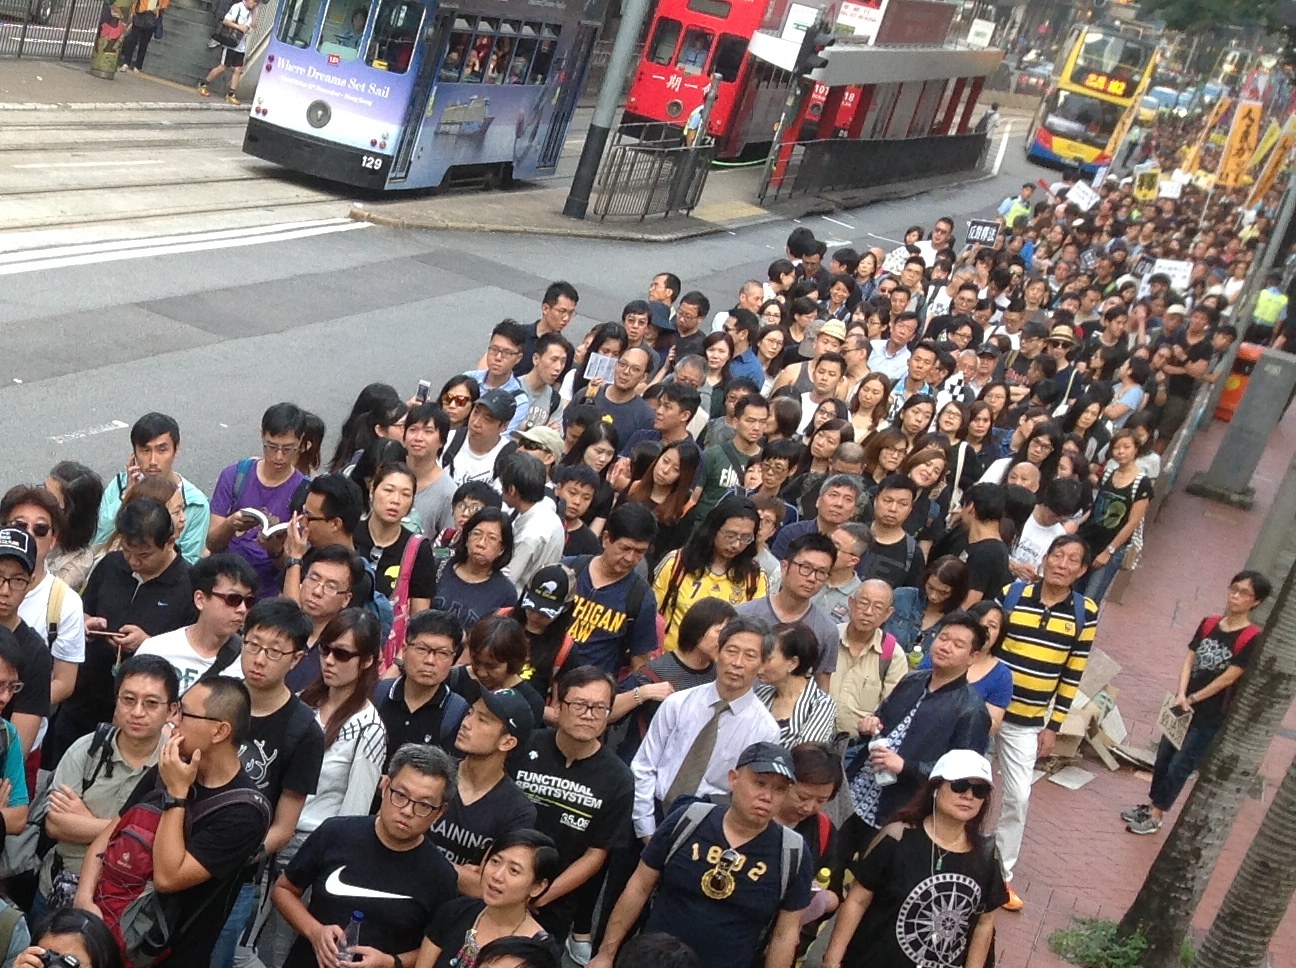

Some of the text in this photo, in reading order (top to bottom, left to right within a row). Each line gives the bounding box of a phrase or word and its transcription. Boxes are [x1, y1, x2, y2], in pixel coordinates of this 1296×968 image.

[277, 57, 306, 75] Where
[307, 66, 347, 87] Dreams
[348, 77, 366, 92] Set
[368, 83, 391, 98] Sail
[361, 155, 383, 171] 129
[515, 780, 603, 810] SPORTSYSTEM
[516, 770, 594, 797] FUNCTIONAL
